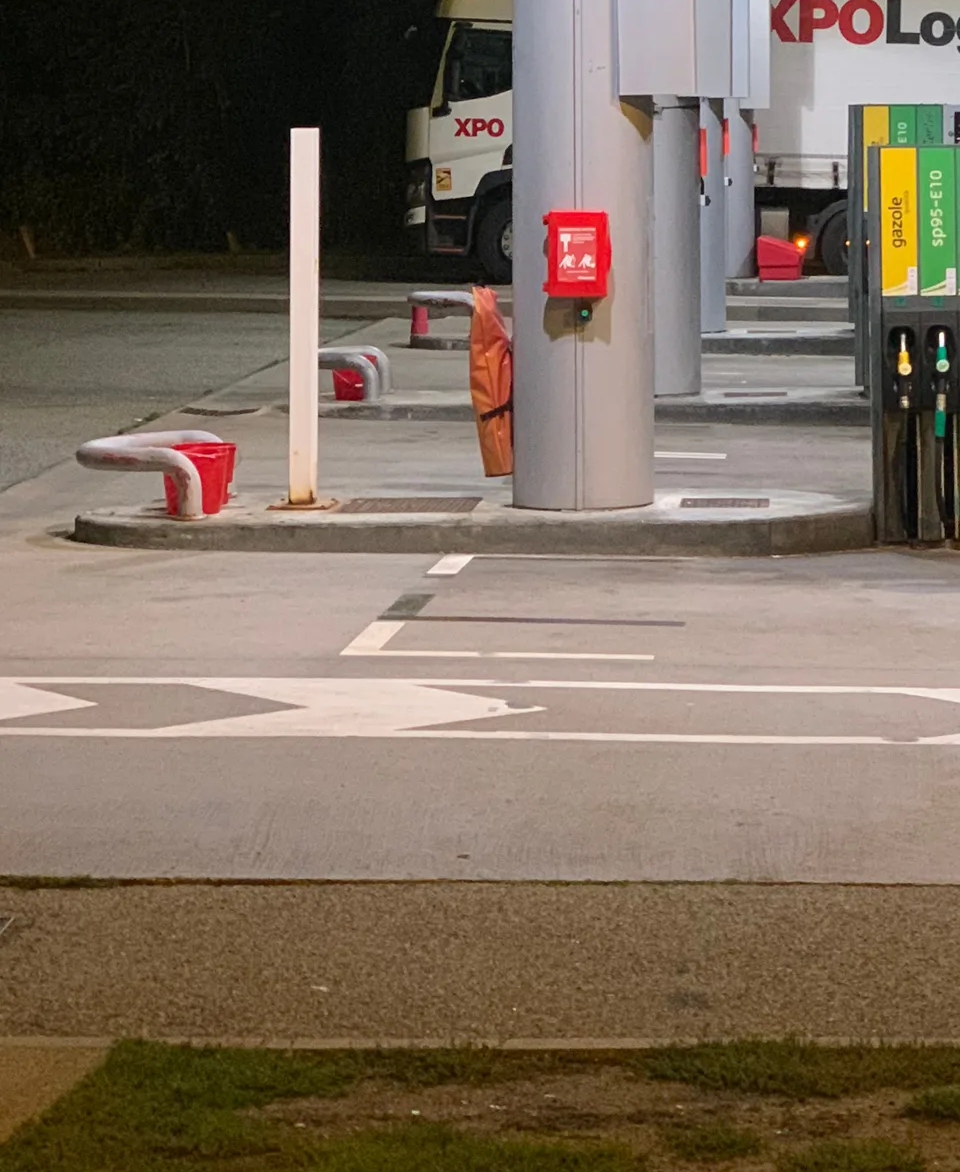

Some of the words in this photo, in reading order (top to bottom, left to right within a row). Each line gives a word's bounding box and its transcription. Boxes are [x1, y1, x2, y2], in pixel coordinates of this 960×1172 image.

[454, 118, 505, 138] XPO
[888, 196, 907, 248] gazole
[930, 170, 946, 247] sp95-E10
